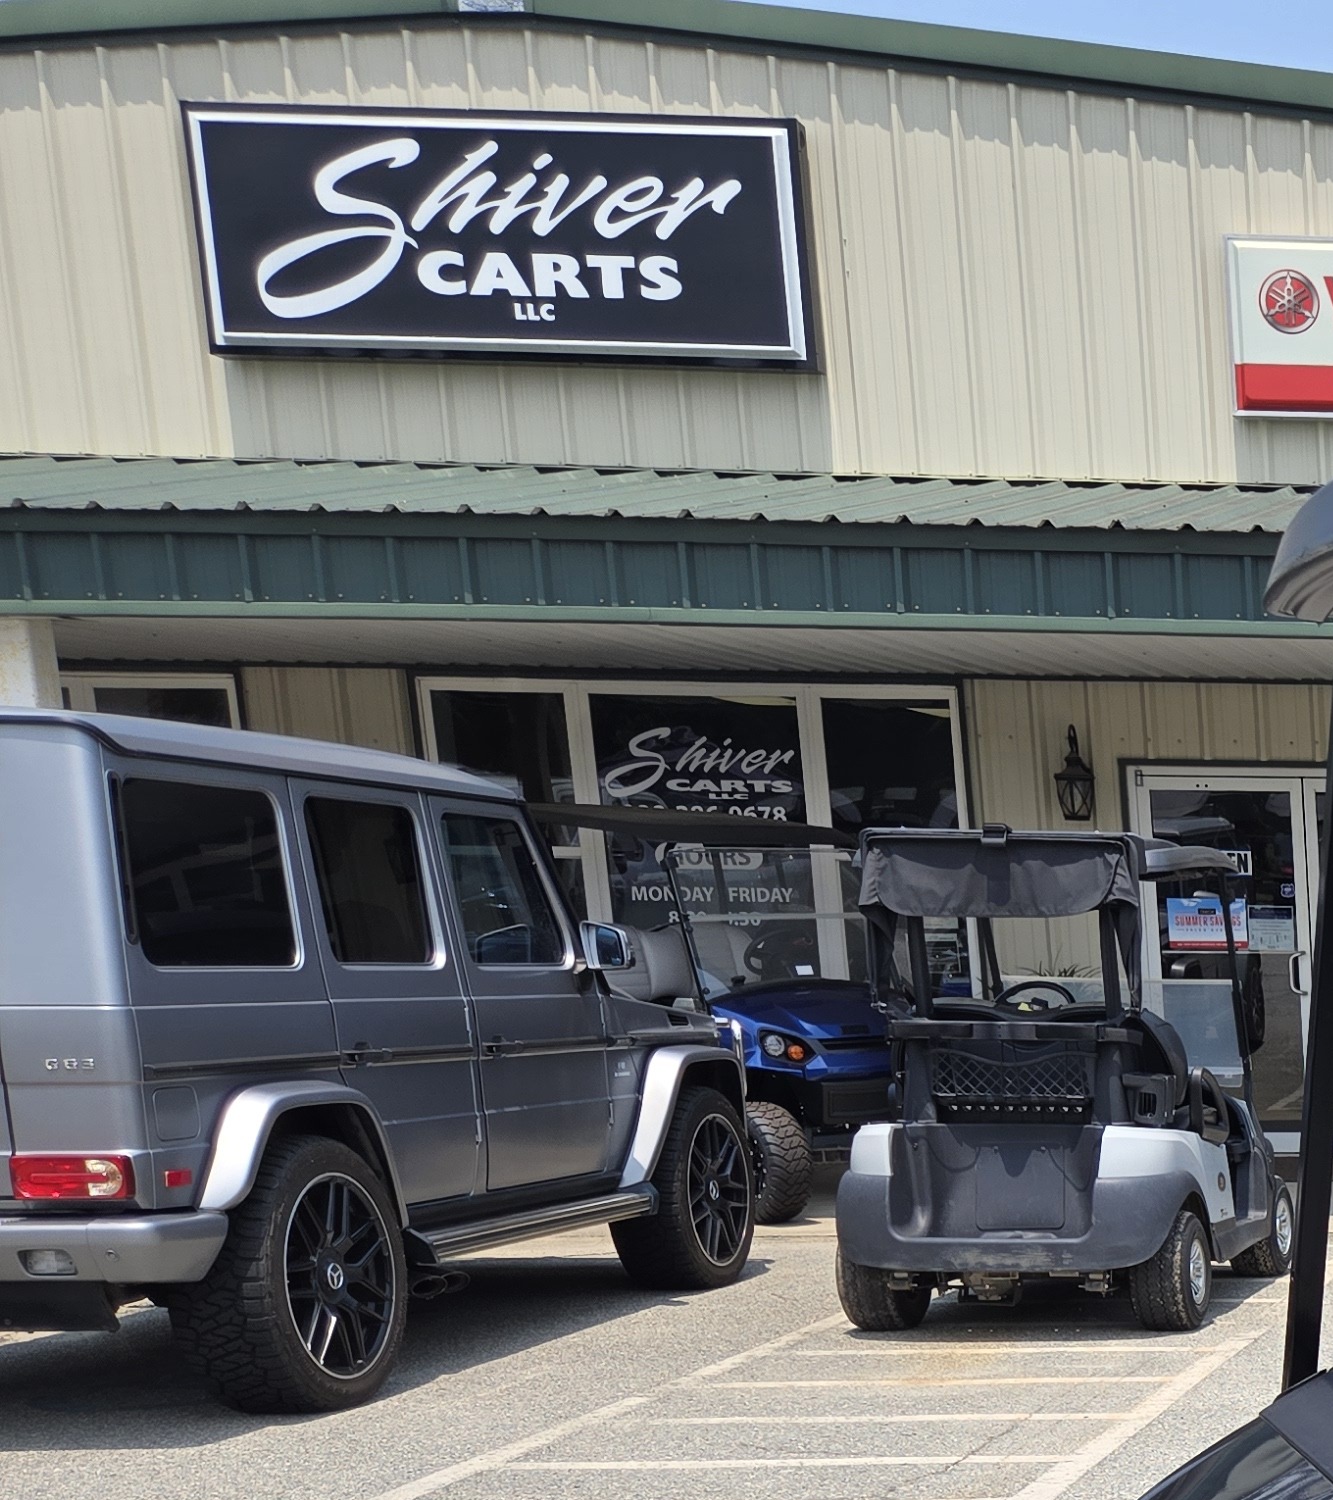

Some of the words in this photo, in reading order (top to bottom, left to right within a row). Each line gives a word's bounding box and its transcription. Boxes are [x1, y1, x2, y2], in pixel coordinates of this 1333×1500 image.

[257, 138, 742, 318] Shiver
[417, 249, 683, 301] CARTS
[514, 302, 556, 322] LLC
[605, 726, 795, 799] Shiver
[666, 779, 794, 793] CARTS
[631, 886, 714, 902] MONDAY
[728, 887, 792, 903] FRIDAY
[1174, 915, 1209, 927] SUMMER
[1210, 915, 1242, 927] SAVGS
